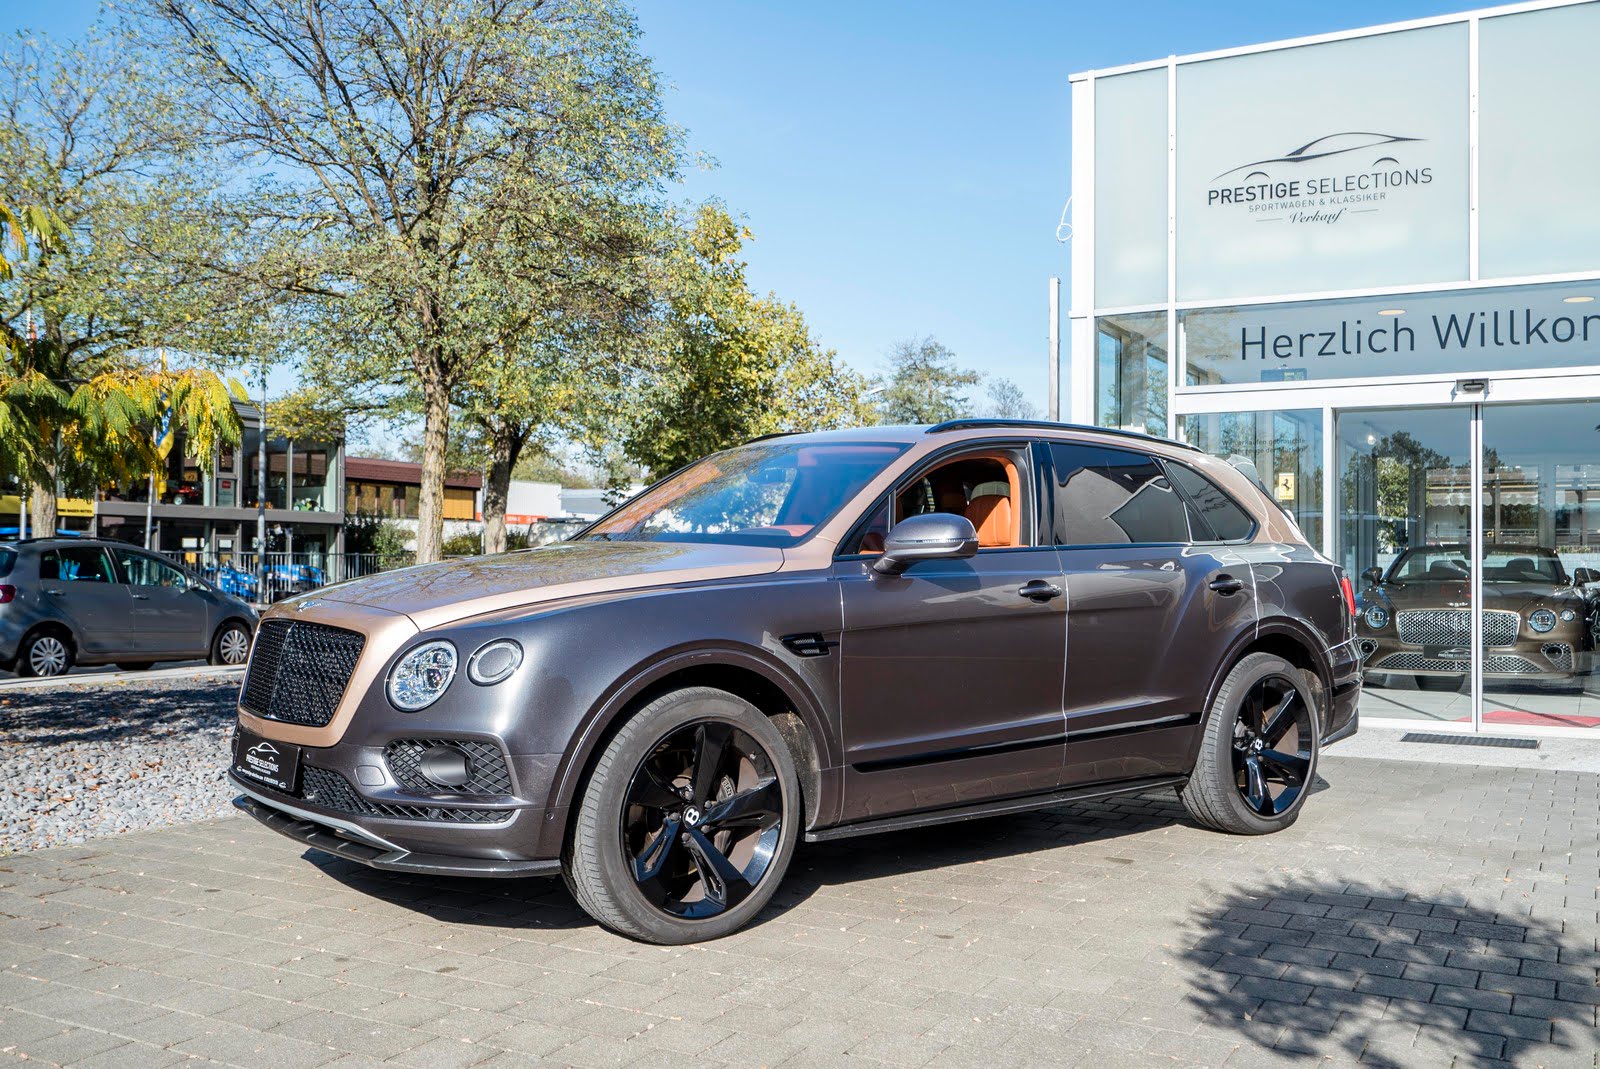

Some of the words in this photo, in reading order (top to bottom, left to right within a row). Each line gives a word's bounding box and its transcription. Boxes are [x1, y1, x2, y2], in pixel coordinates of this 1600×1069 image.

[1208, 181, 1300, 206] PRESTIGE
[1306, 167, 1433, 195] SELECTIONS
[1248, 199, 1315, 213] SPORTWAGEN
[1319, 198, 1326, 206] &
[1329, 192, 1387, 205] KLASSIKER
[1289, 207, 1347, 224] Verkauf
[1242, 317, 1415, 360] Herzlich
